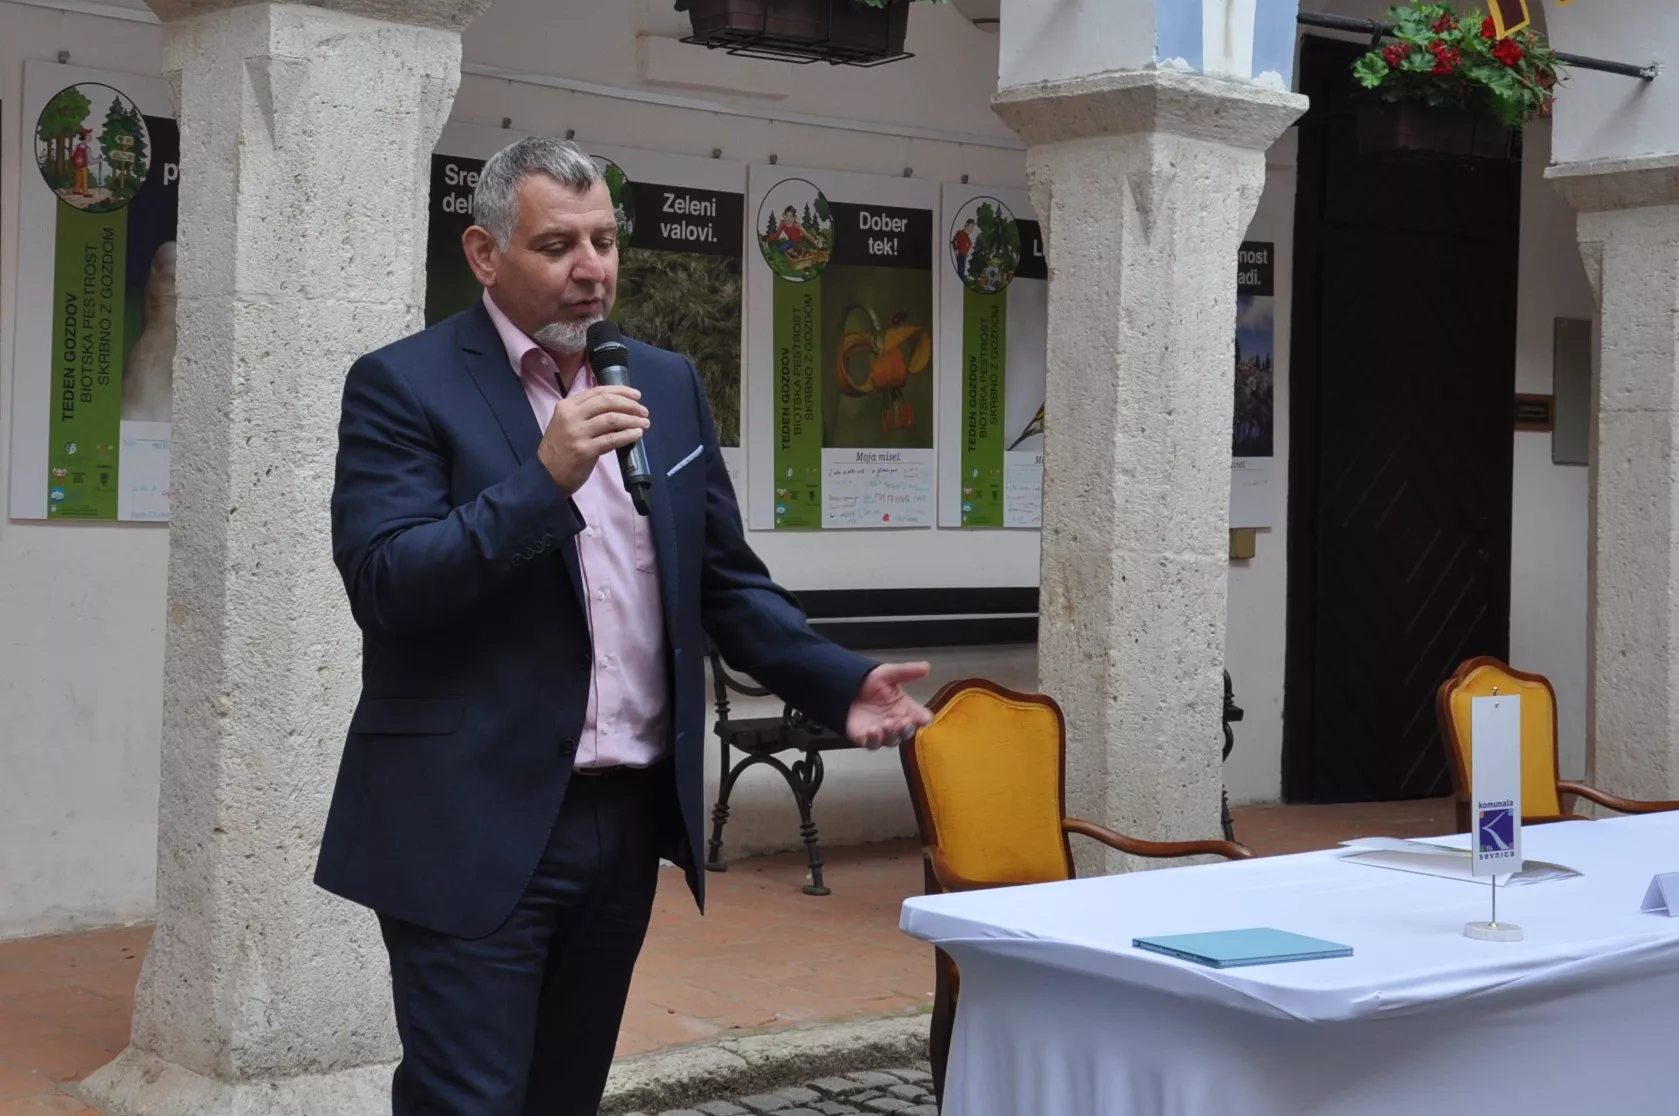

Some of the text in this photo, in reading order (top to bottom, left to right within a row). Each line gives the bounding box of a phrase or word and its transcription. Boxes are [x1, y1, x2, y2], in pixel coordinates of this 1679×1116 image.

[444, 163, 481, 188] Sre
[662, 192, 716, 217] Zeleni
[859, 211, 908, 232] Dober
[660, 220, 718, 243] valovi.
[868, 236, 898, 256] tek!
[80, 242, 98, 403] BIOTSKA PESTROST
[97, 227, 115, 386] SKRBNO Z GOZDOM
[62, 292, 78, 422] TEDEN GOZDOV
[792, 305, 802, 436] BIOTSKA PESTROST
[804, 293, 814, 421] SKRBNO Z GOZDOM
[979, 316, 989, 438] BIOTSKA PESTROST
[781, 347, 791, 452] TEDEN GOZDOV
[968, 355, 978, 453] TEDEN GOZDOV
[990, 374, 998, 425] SKRBNO
[856, 451, 877, 463] Moja
[1478, 799, 1514, 809] komunala
[1479, 851, 1515, 860] sevnica
